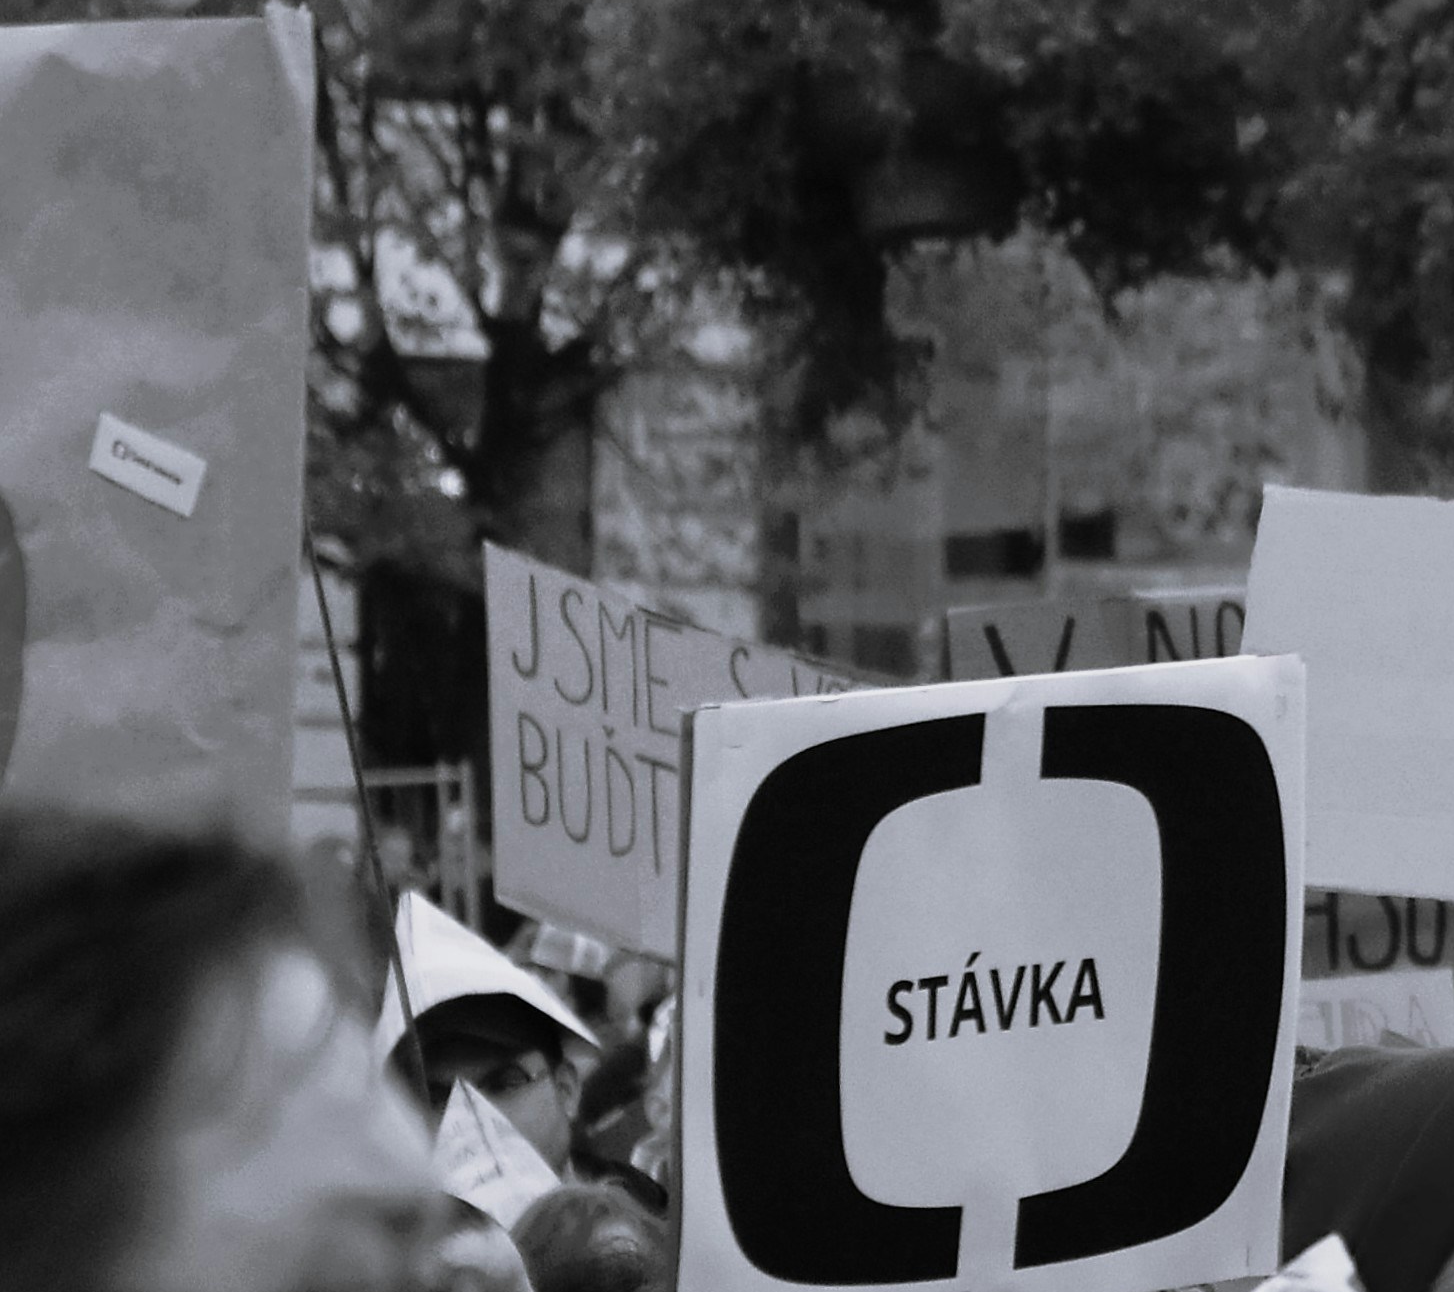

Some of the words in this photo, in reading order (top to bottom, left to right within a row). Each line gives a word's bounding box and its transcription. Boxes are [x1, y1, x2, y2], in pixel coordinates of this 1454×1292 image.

[513, 574, 682, 737] JSME
[519, 711, 680, 877] BUĎT
[883, 950, 1106, 1046] STÁVKA
